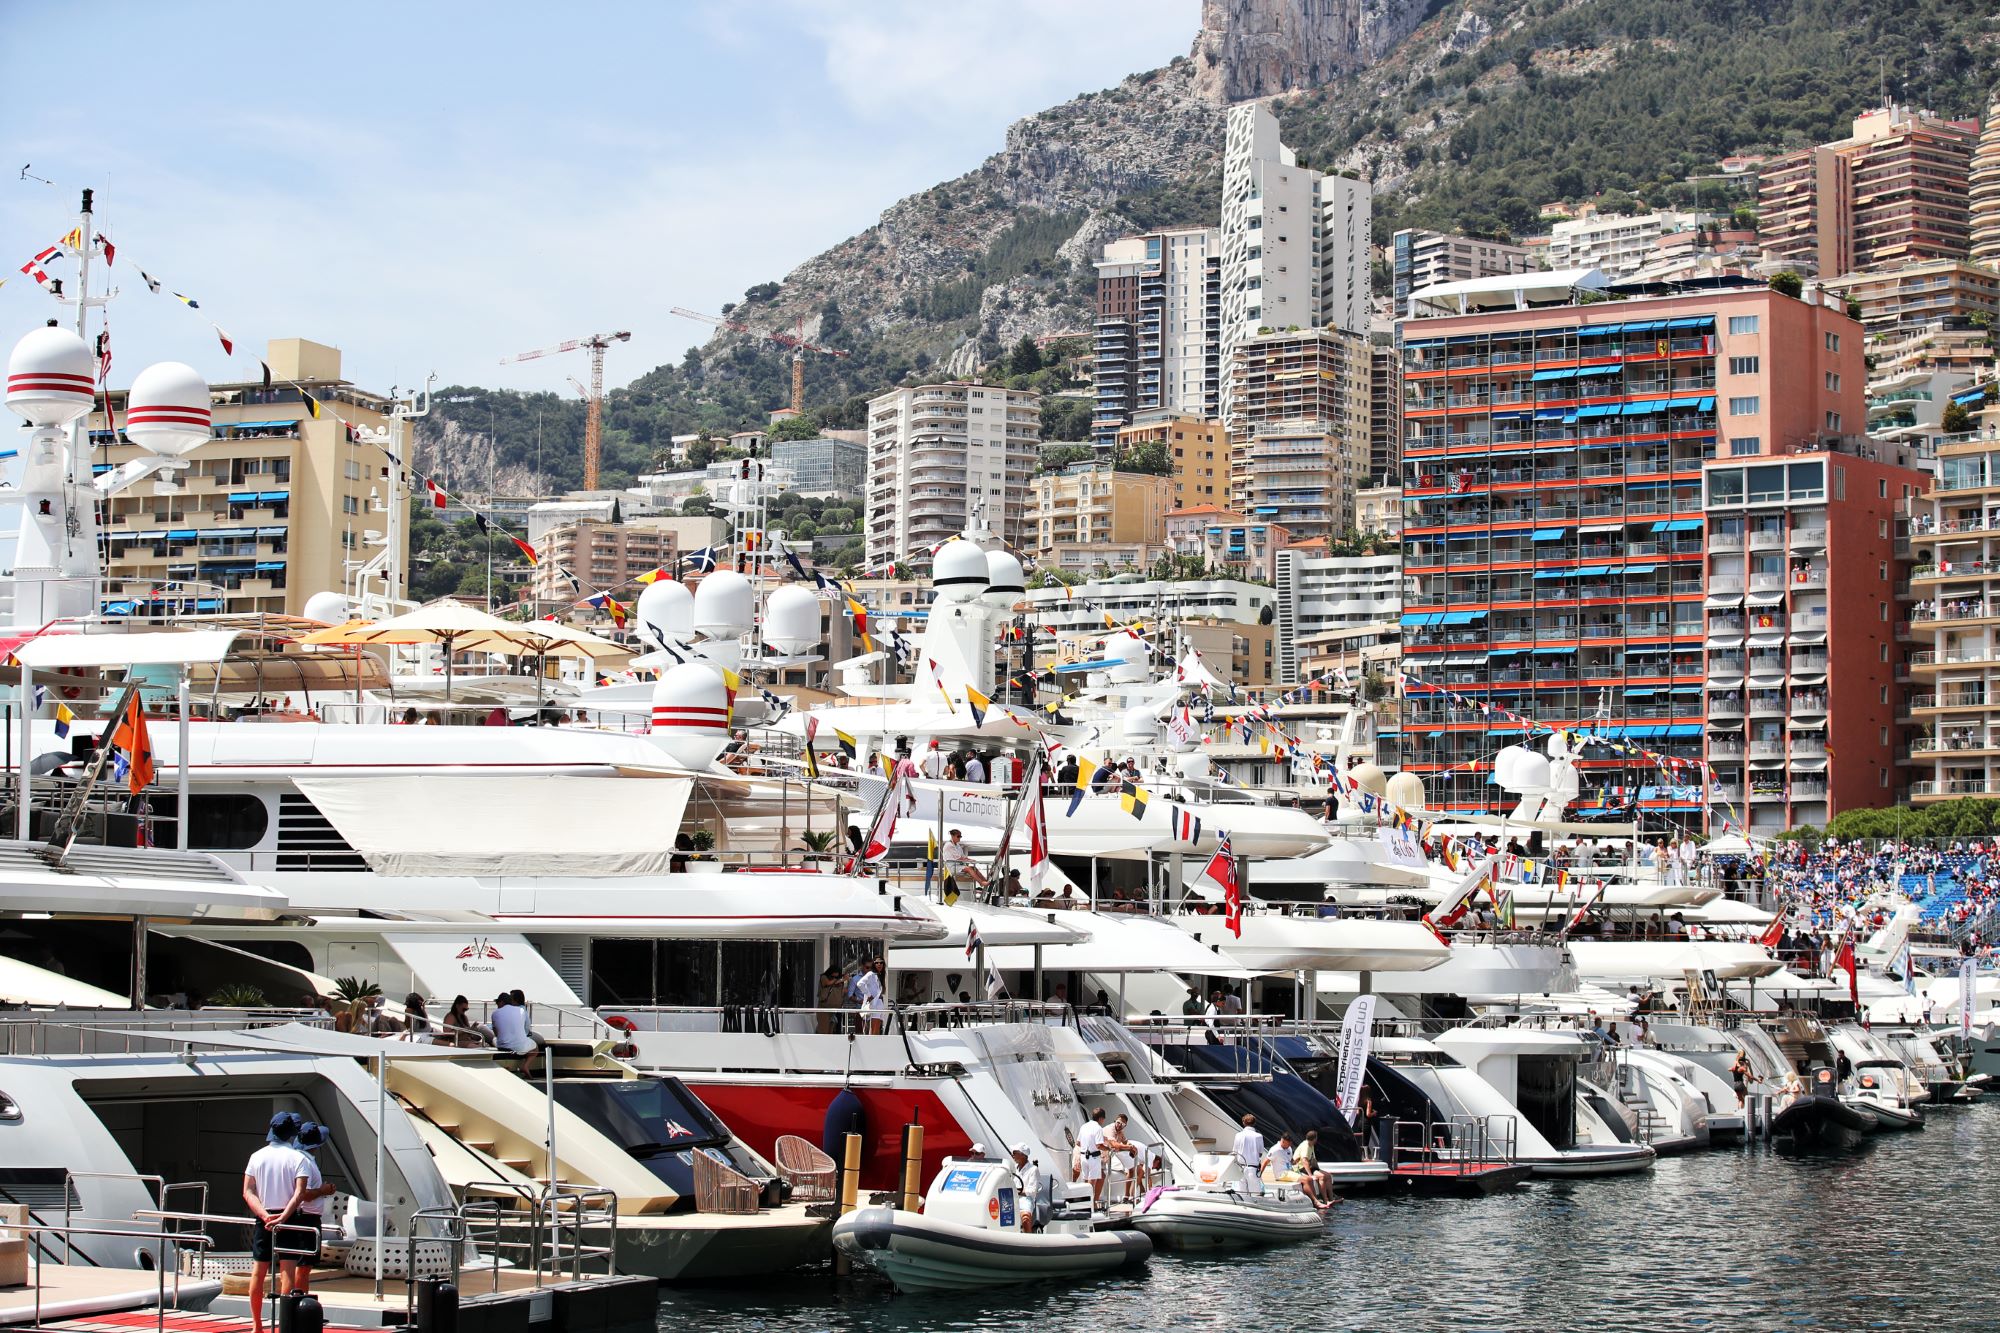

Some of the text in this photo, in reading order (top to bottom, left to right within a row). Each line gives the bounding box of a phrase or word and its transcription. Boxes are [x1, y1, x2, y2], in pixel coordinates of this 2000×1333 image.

[1170, 716, 1190, 743] UBS
[1337, 1027, 1352, 1093] Experiences
[1343, 1001, 1368, 1116] hampions Club
